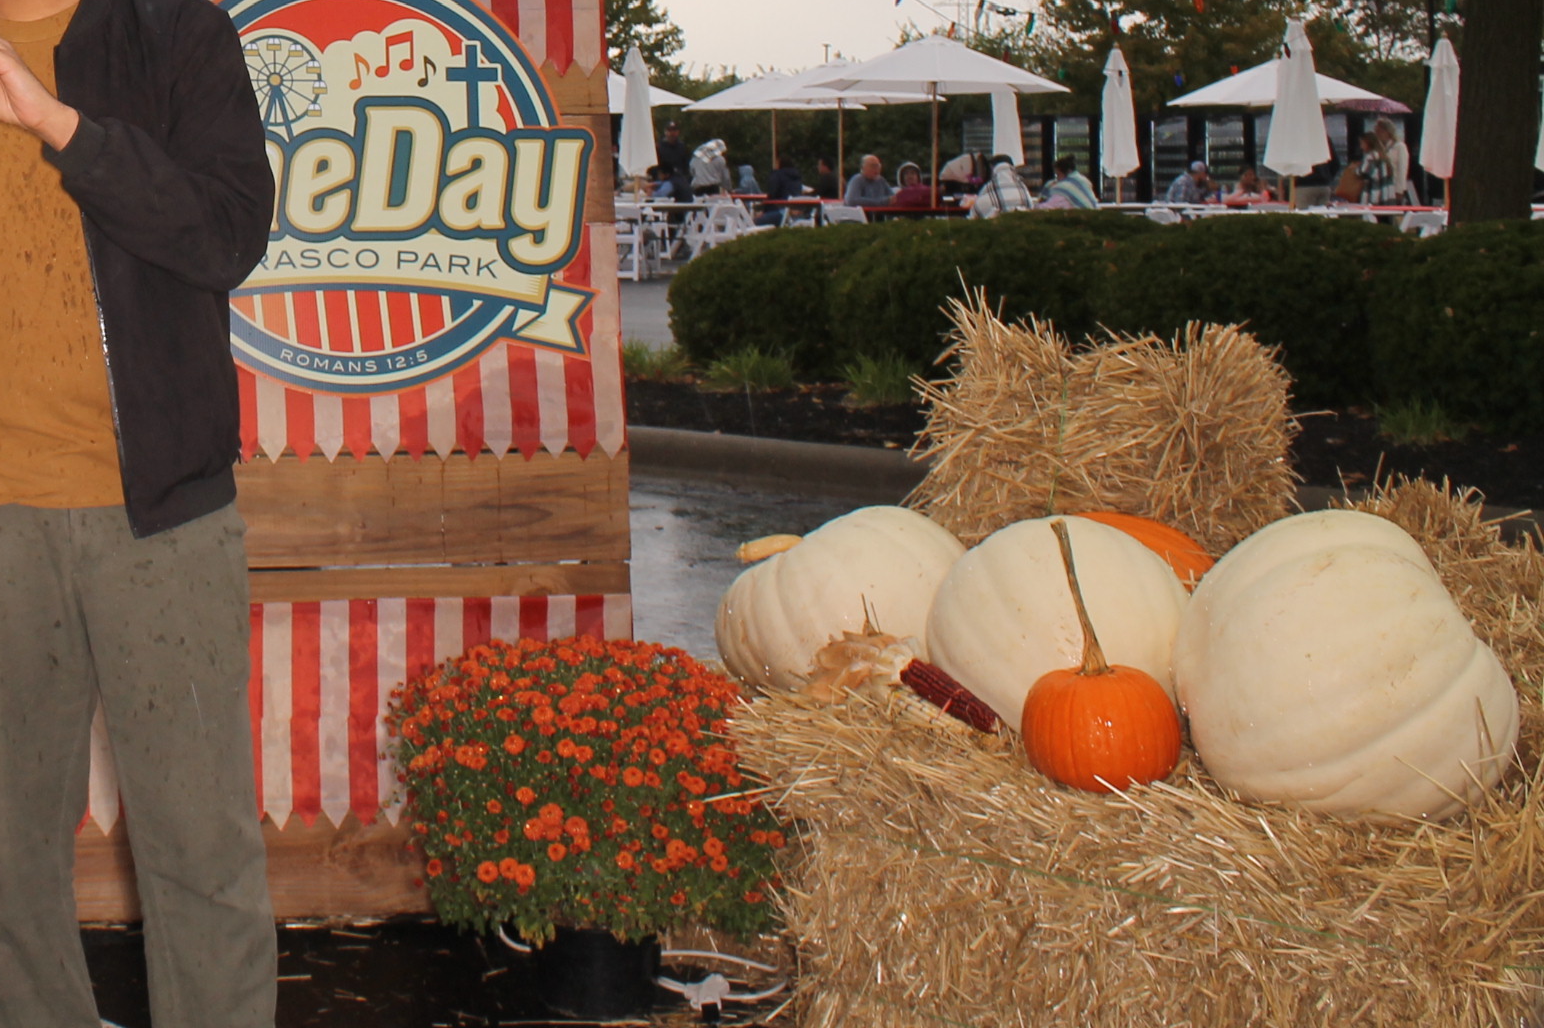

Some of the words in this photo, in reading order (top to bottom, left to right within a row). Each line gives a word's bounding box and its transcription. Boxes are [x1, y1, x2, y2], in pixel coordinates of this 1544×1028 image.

[397, 250, 498, 279] PARK
[280, 348, 377, 372] ROMANS
[387, 350, 428, 370] 12:5
